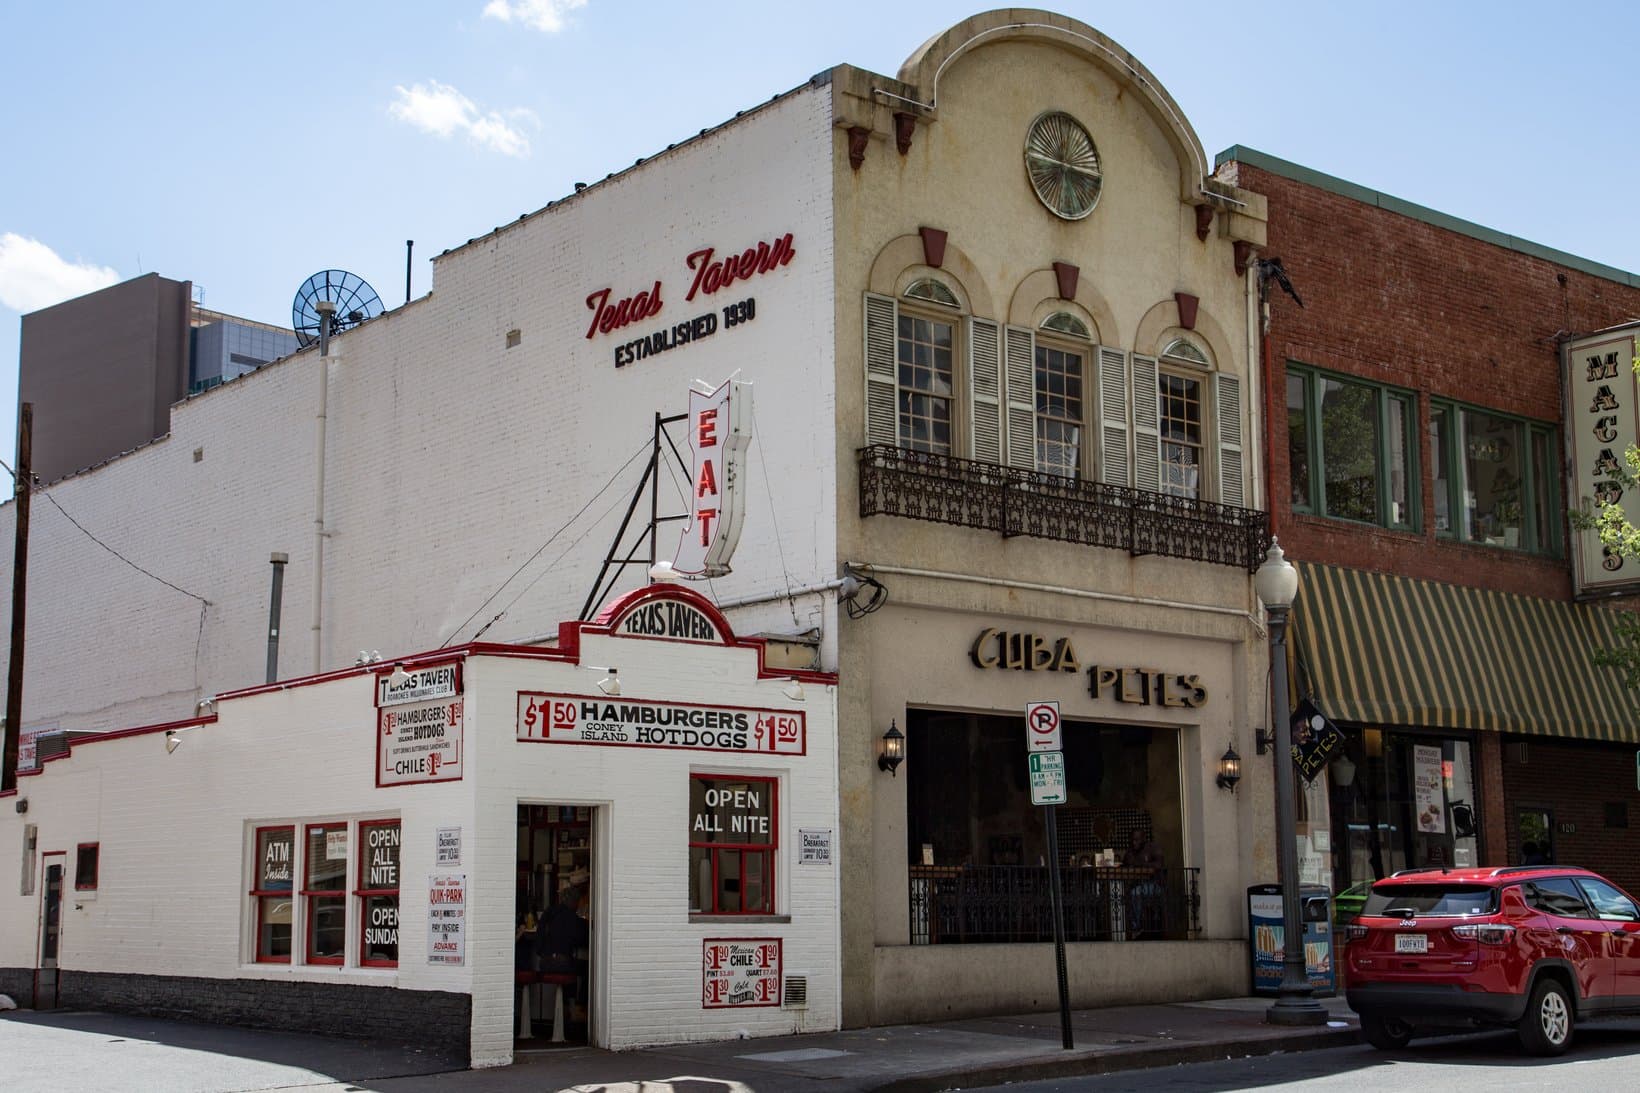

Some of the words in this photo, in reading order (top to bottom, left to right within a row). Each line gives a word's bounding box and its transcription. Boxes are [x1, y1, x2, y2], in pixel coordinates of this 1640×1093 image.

[585, 281, 664, 340] Texas
[685, 233, 796, 301] Tavern
[614, 313, 717, 368] ESTABLISHED
[722, 298, 756, 329] 1930
[1586, 351, 1625, 571] MACADS
[696, 408, 718, 547] EAT
[625, 602, 666, 636] TEXAS
[665, 602, 715, 640] TAVERN
[968, 627, 1081, 673] CUBA
[420, 668, 457, 692] TAVERN
[397, 706, 446, 726] HAMBURGERS
[580, 702, 749, 732] HAMBURGERS
[413, 723, 445, 740] HOTDOGS
[586, 722, 624, 732] CONEY
[581, 731, 628, 742] ISLAND
[635, 726, 748, 749] HOTDOGS
[395, 758, 425, 775] CHILE
[705, 788, 760, 809] OPEN
[694, 814, 723, 832] ALL
[731, 815, 769, 834] NITE
[369, 829, 399, 848] OPEN
[266, 842, 289, 862] ATM
[373, 848, 393, 865] ALL
[264, 863, 289, 880] Inside
[370, 866, 396, 884] NITE
[430, 888, 463, 905] QUIK-PARK
[372, 908, 400, 926] OPEN
[1400, 919, 1417, 927] Jeep
[441, 923, 459, 932] INSIDE
[443, 933, 448, 941] IN
[433, 942, 458, 951] ADVANCE
[730, 954, 753, 966] CHILE
[745, 968, 762, 977] QUART
